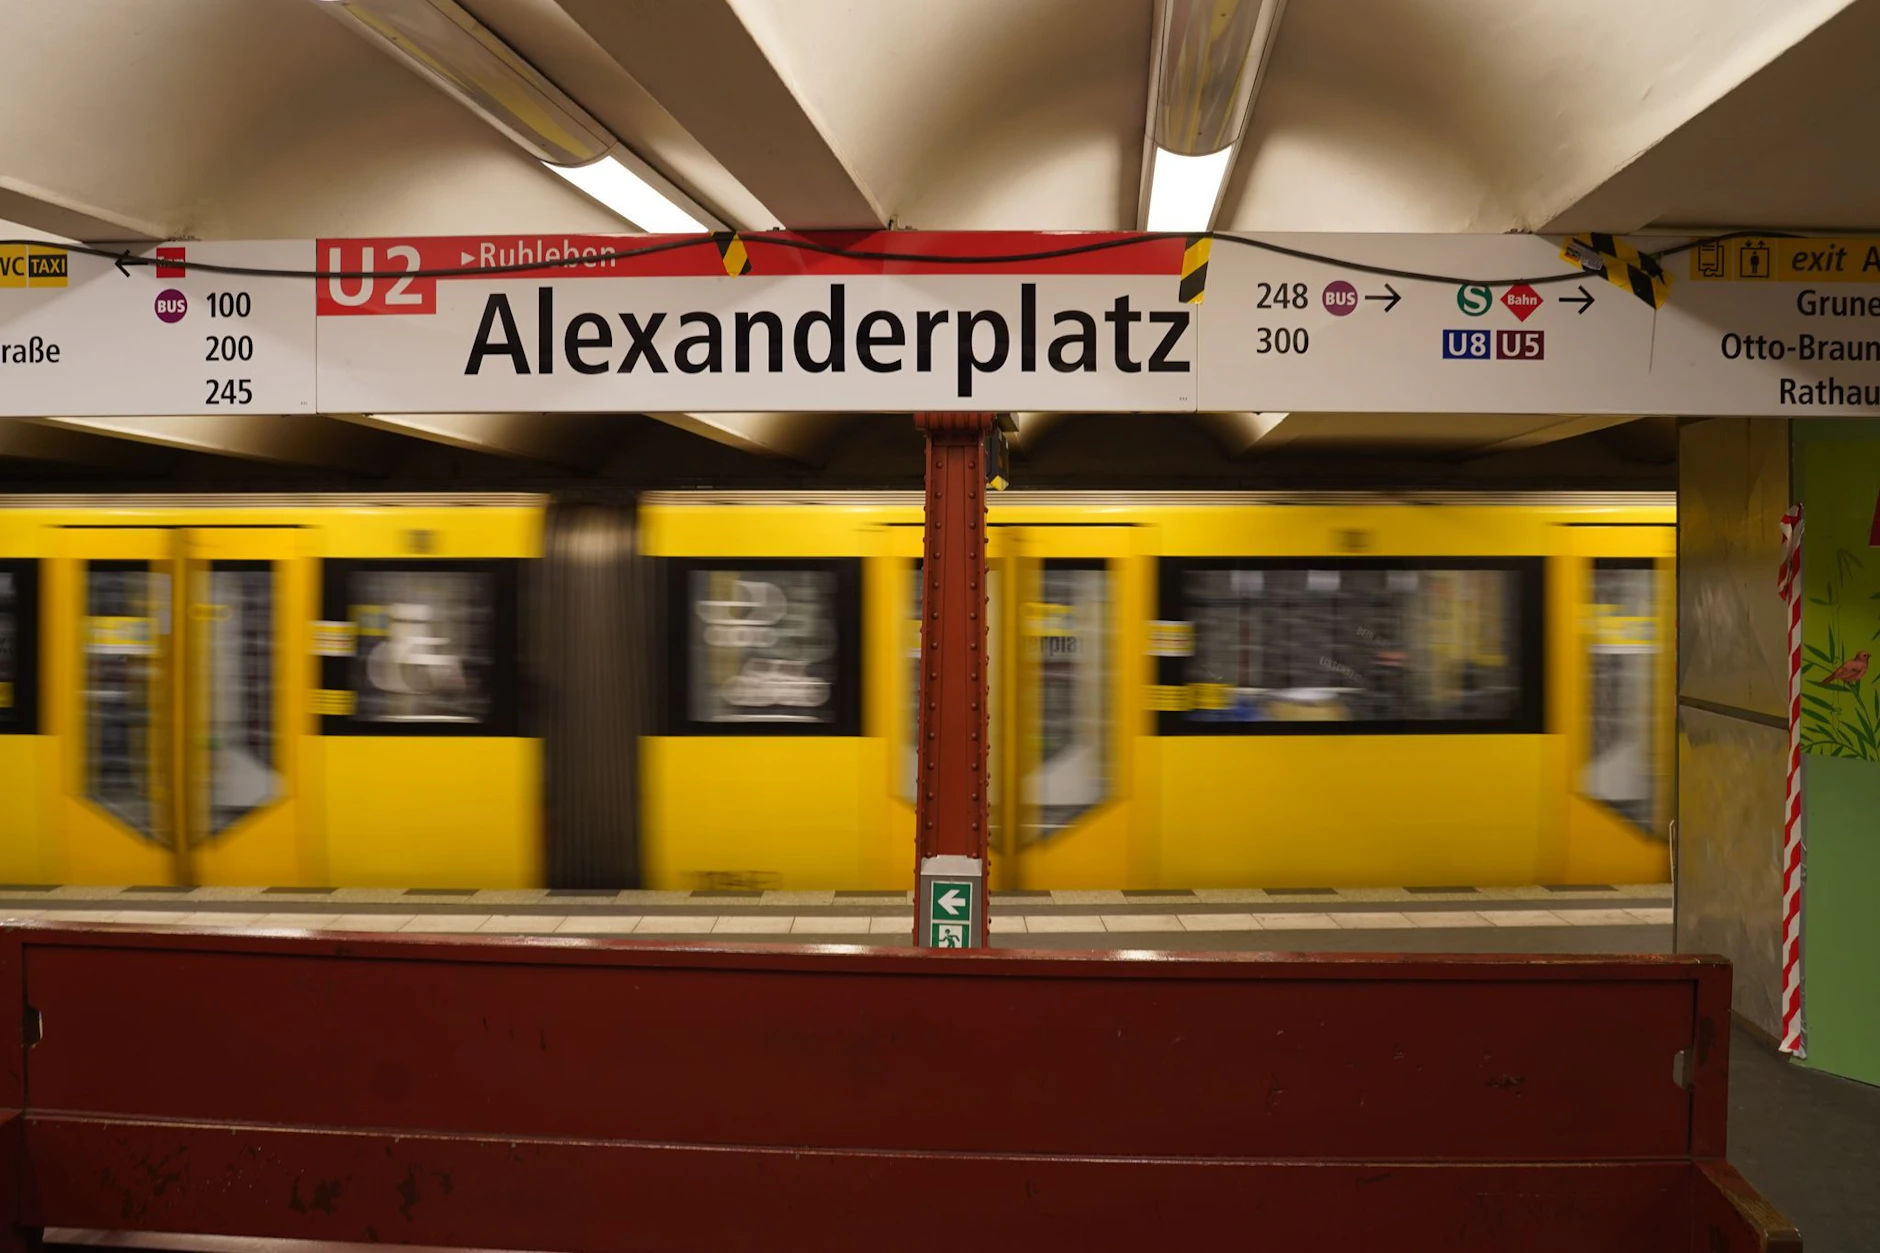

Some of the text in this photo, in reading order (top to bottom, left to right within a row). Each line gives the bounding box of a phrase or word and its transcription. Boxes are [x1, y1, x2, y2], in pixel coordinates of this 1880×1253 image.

[31, 259, 65, 273] TAXI
[480, 239, 616, 268] Ruhleben
[1792, 243, 1846, 271] exit
[329, 245, 422, 306] U2
[158, 292, 251, 318] BUS 100
[1257, 282, 1355, 309] 248 BUS
[1464, 284, 1537, 313] S Bahn
[1797, 289, 1880, 317] Grune
[205, 336, 253, 361] 200
[464, 283, 1190, 397] Alexanderplatz
[1257, 327, 1309, 354] 300
[1449, 333, 1539, 357] U8 U5
[1721, 333, 1880, 361] Otto-Braun
[205, 379, 252, 404] 245
[1780, 377, 1880, 405] Rathau
